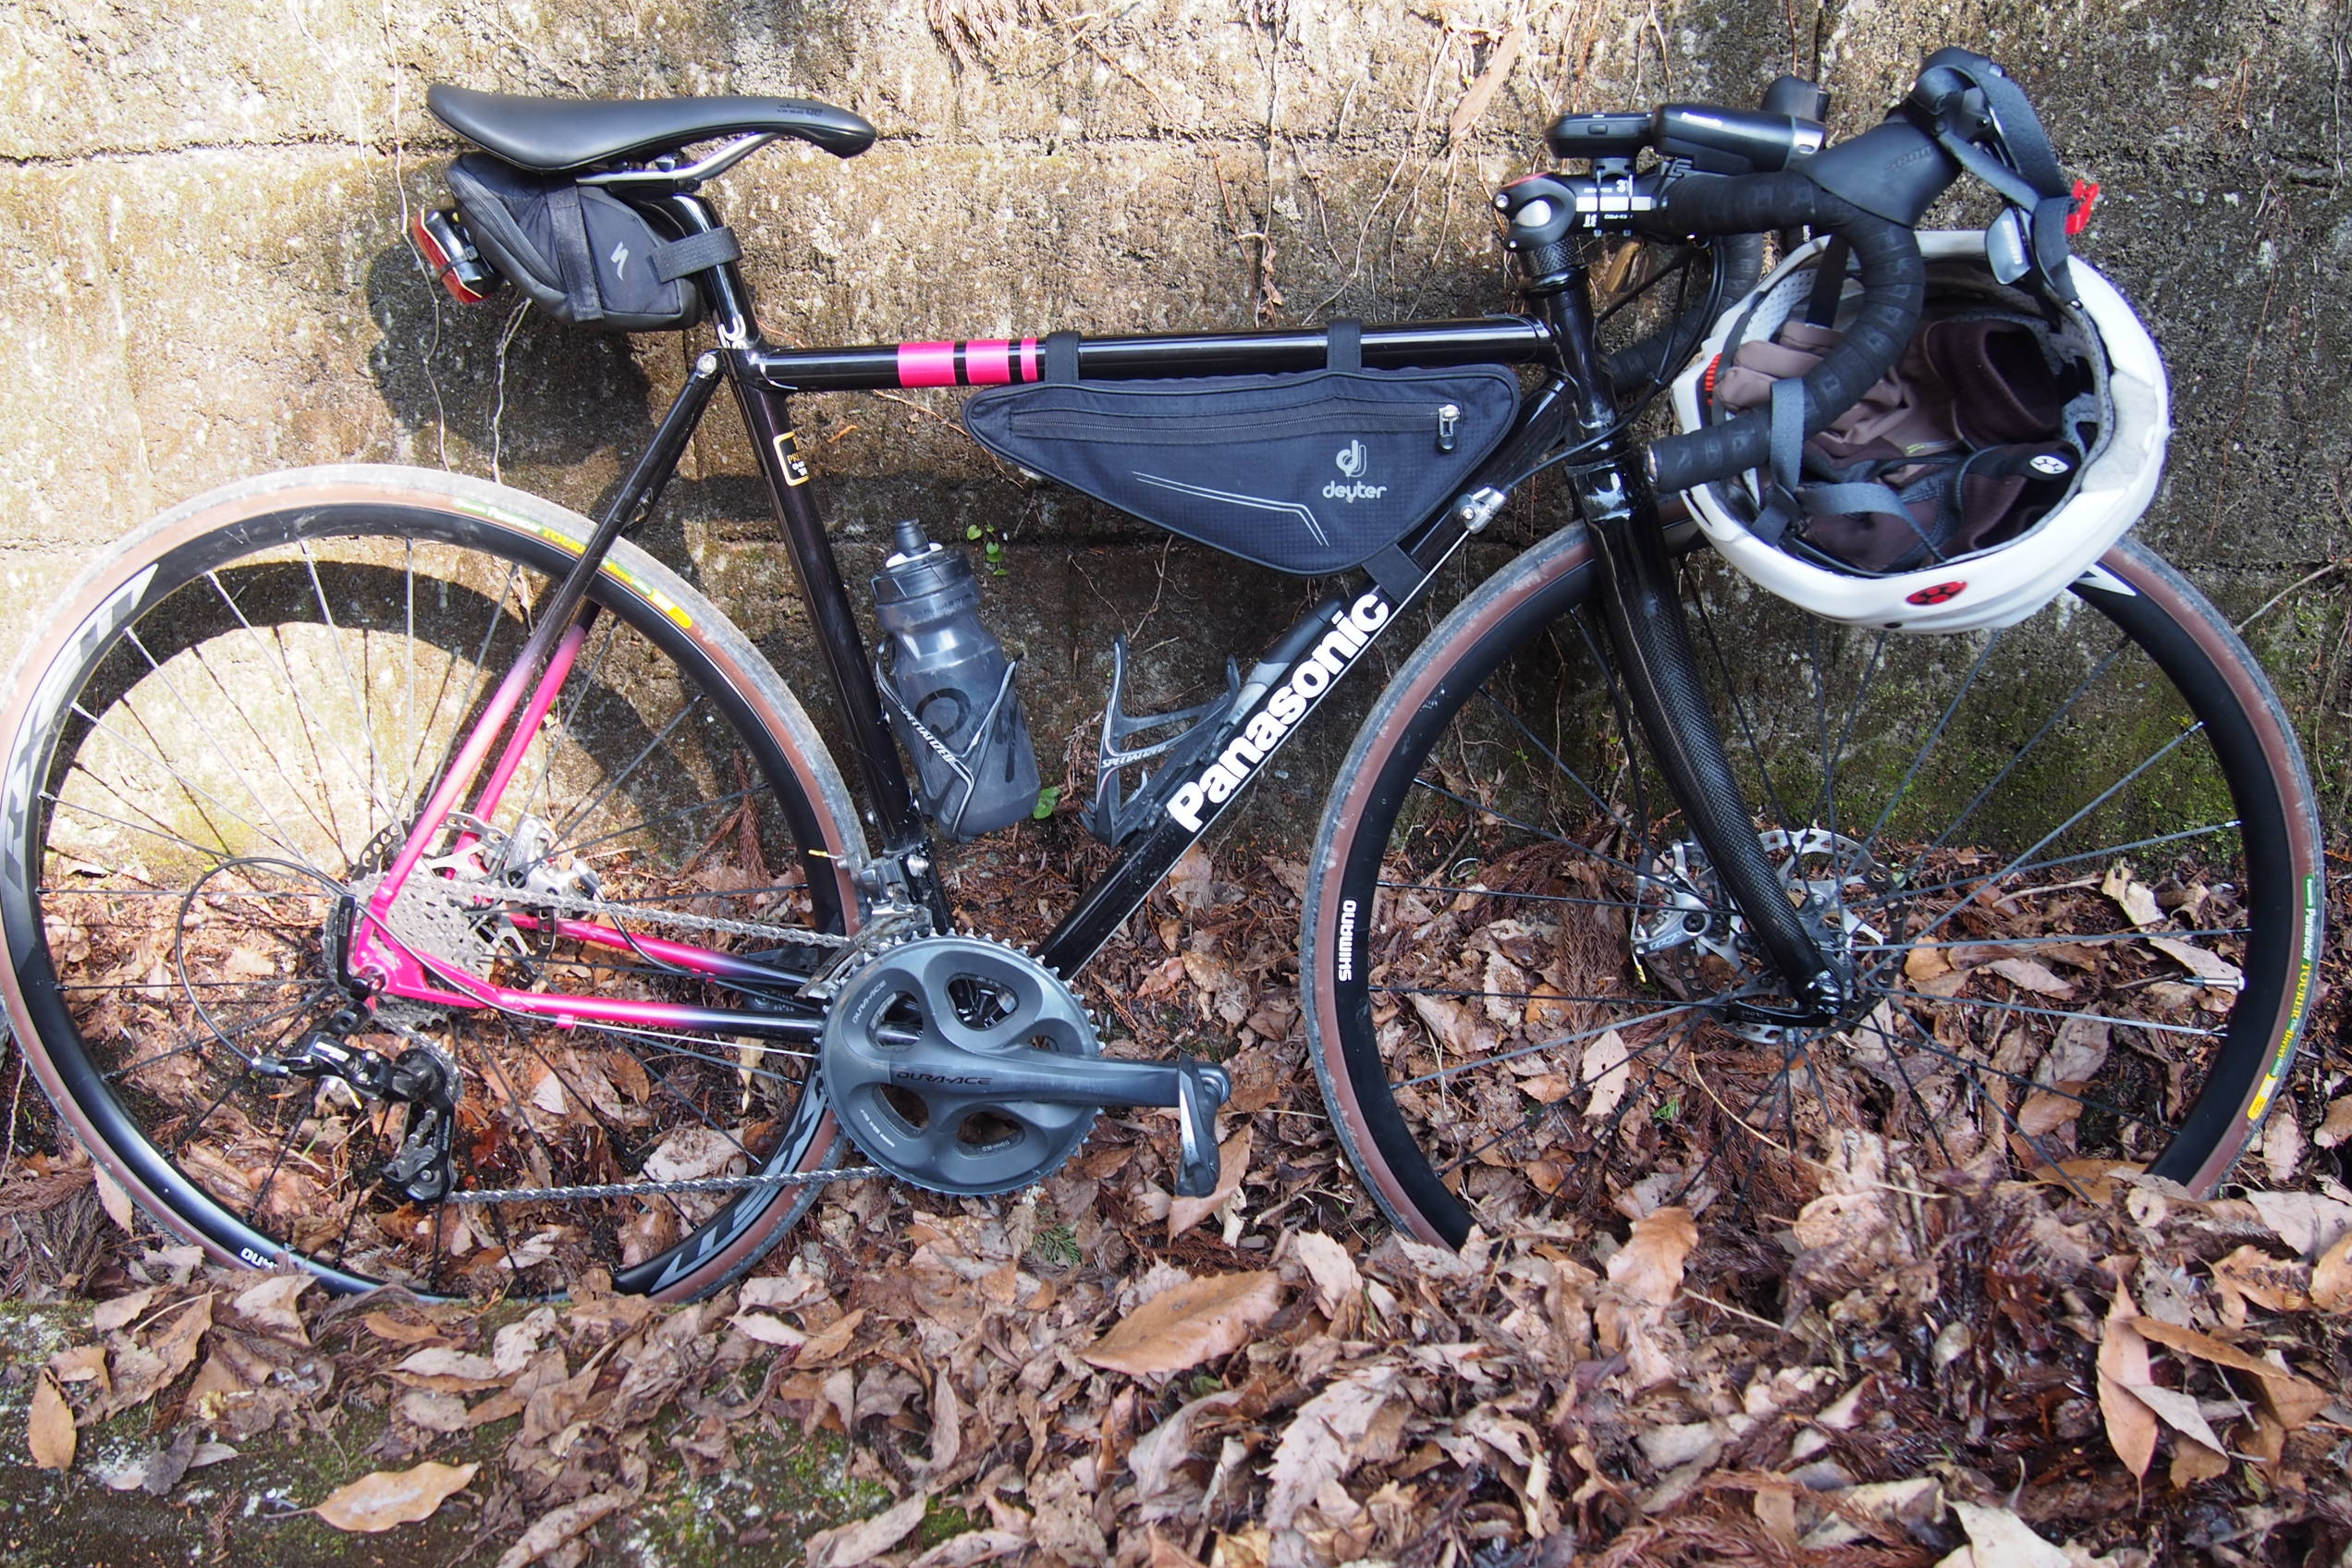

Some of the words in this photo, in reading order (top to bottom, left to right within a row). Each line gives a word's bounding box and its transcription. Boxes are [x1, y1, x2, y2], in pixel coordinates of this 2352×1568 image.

[899, 703, 958, 763] SPECIALIZED
[1166, 593, 1390, 833] Panasonic
[1338, 900, 1357, 982] SHIMANO
[2291, 963, 2311, 1019] TOURER
[897, 1071, 992, 1085] DURA-ACE
